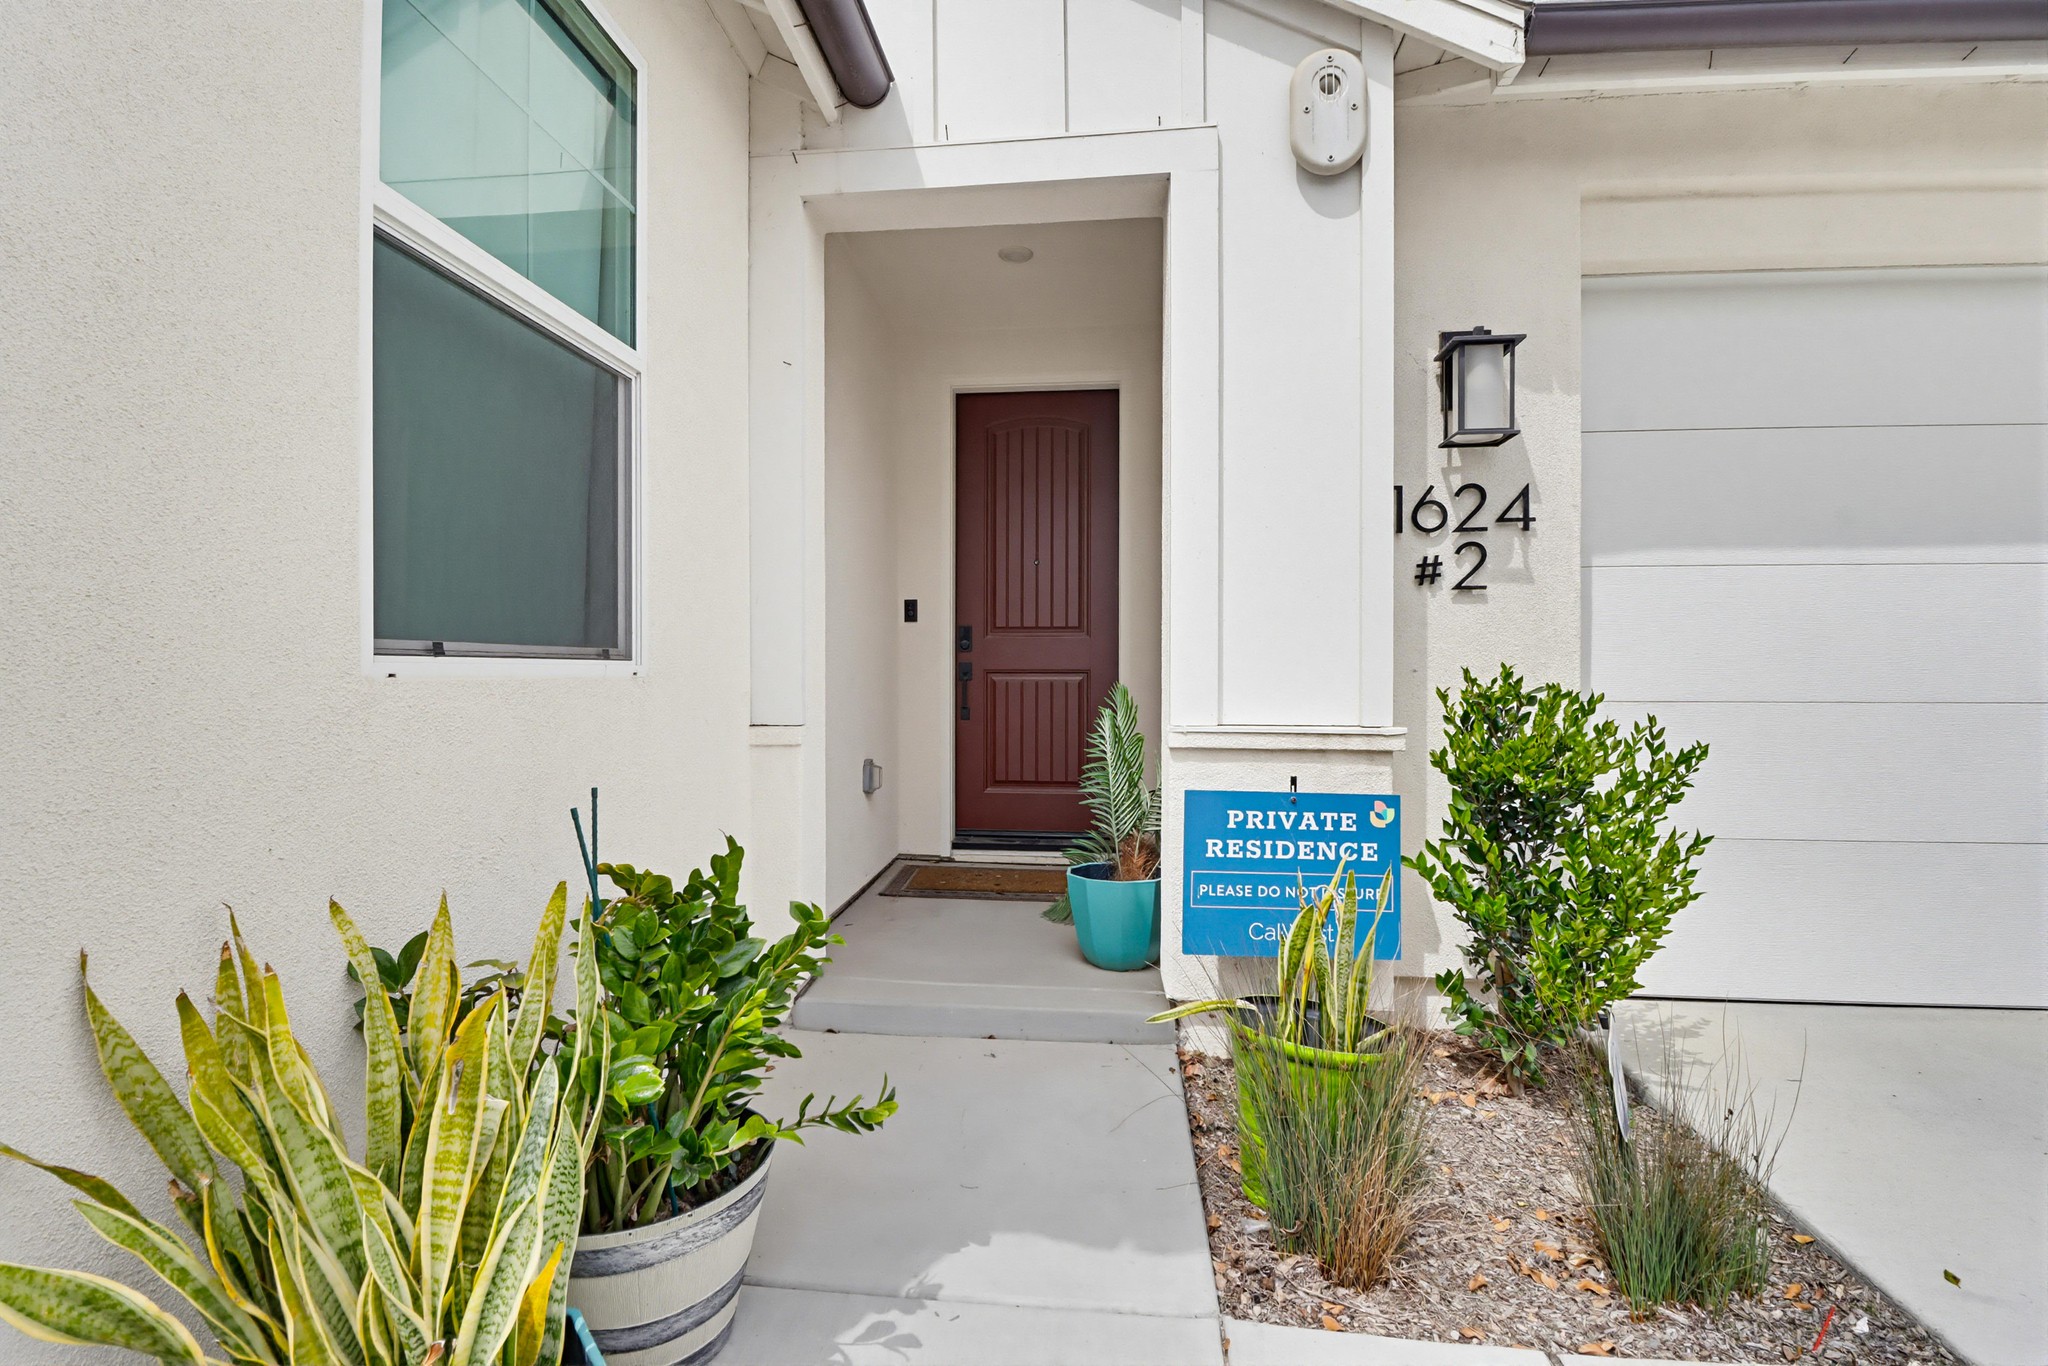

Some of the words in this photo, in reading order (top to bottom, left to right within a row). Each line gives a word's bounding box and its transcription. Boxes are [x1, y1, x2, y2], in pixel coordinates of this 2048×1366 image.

[1394, 482, 1537, 533] 1624
[1414, 541, 1488, 590] #2
[1227, 809, 1357, 832] PRIVATE
[1205, 838, 1378, 862] RESIDENCE
[1200, 884, 1253, 898] PLEASE
[1257, 885, 1280, 898] DO
[1285, 886, 1316, 900] NOT
